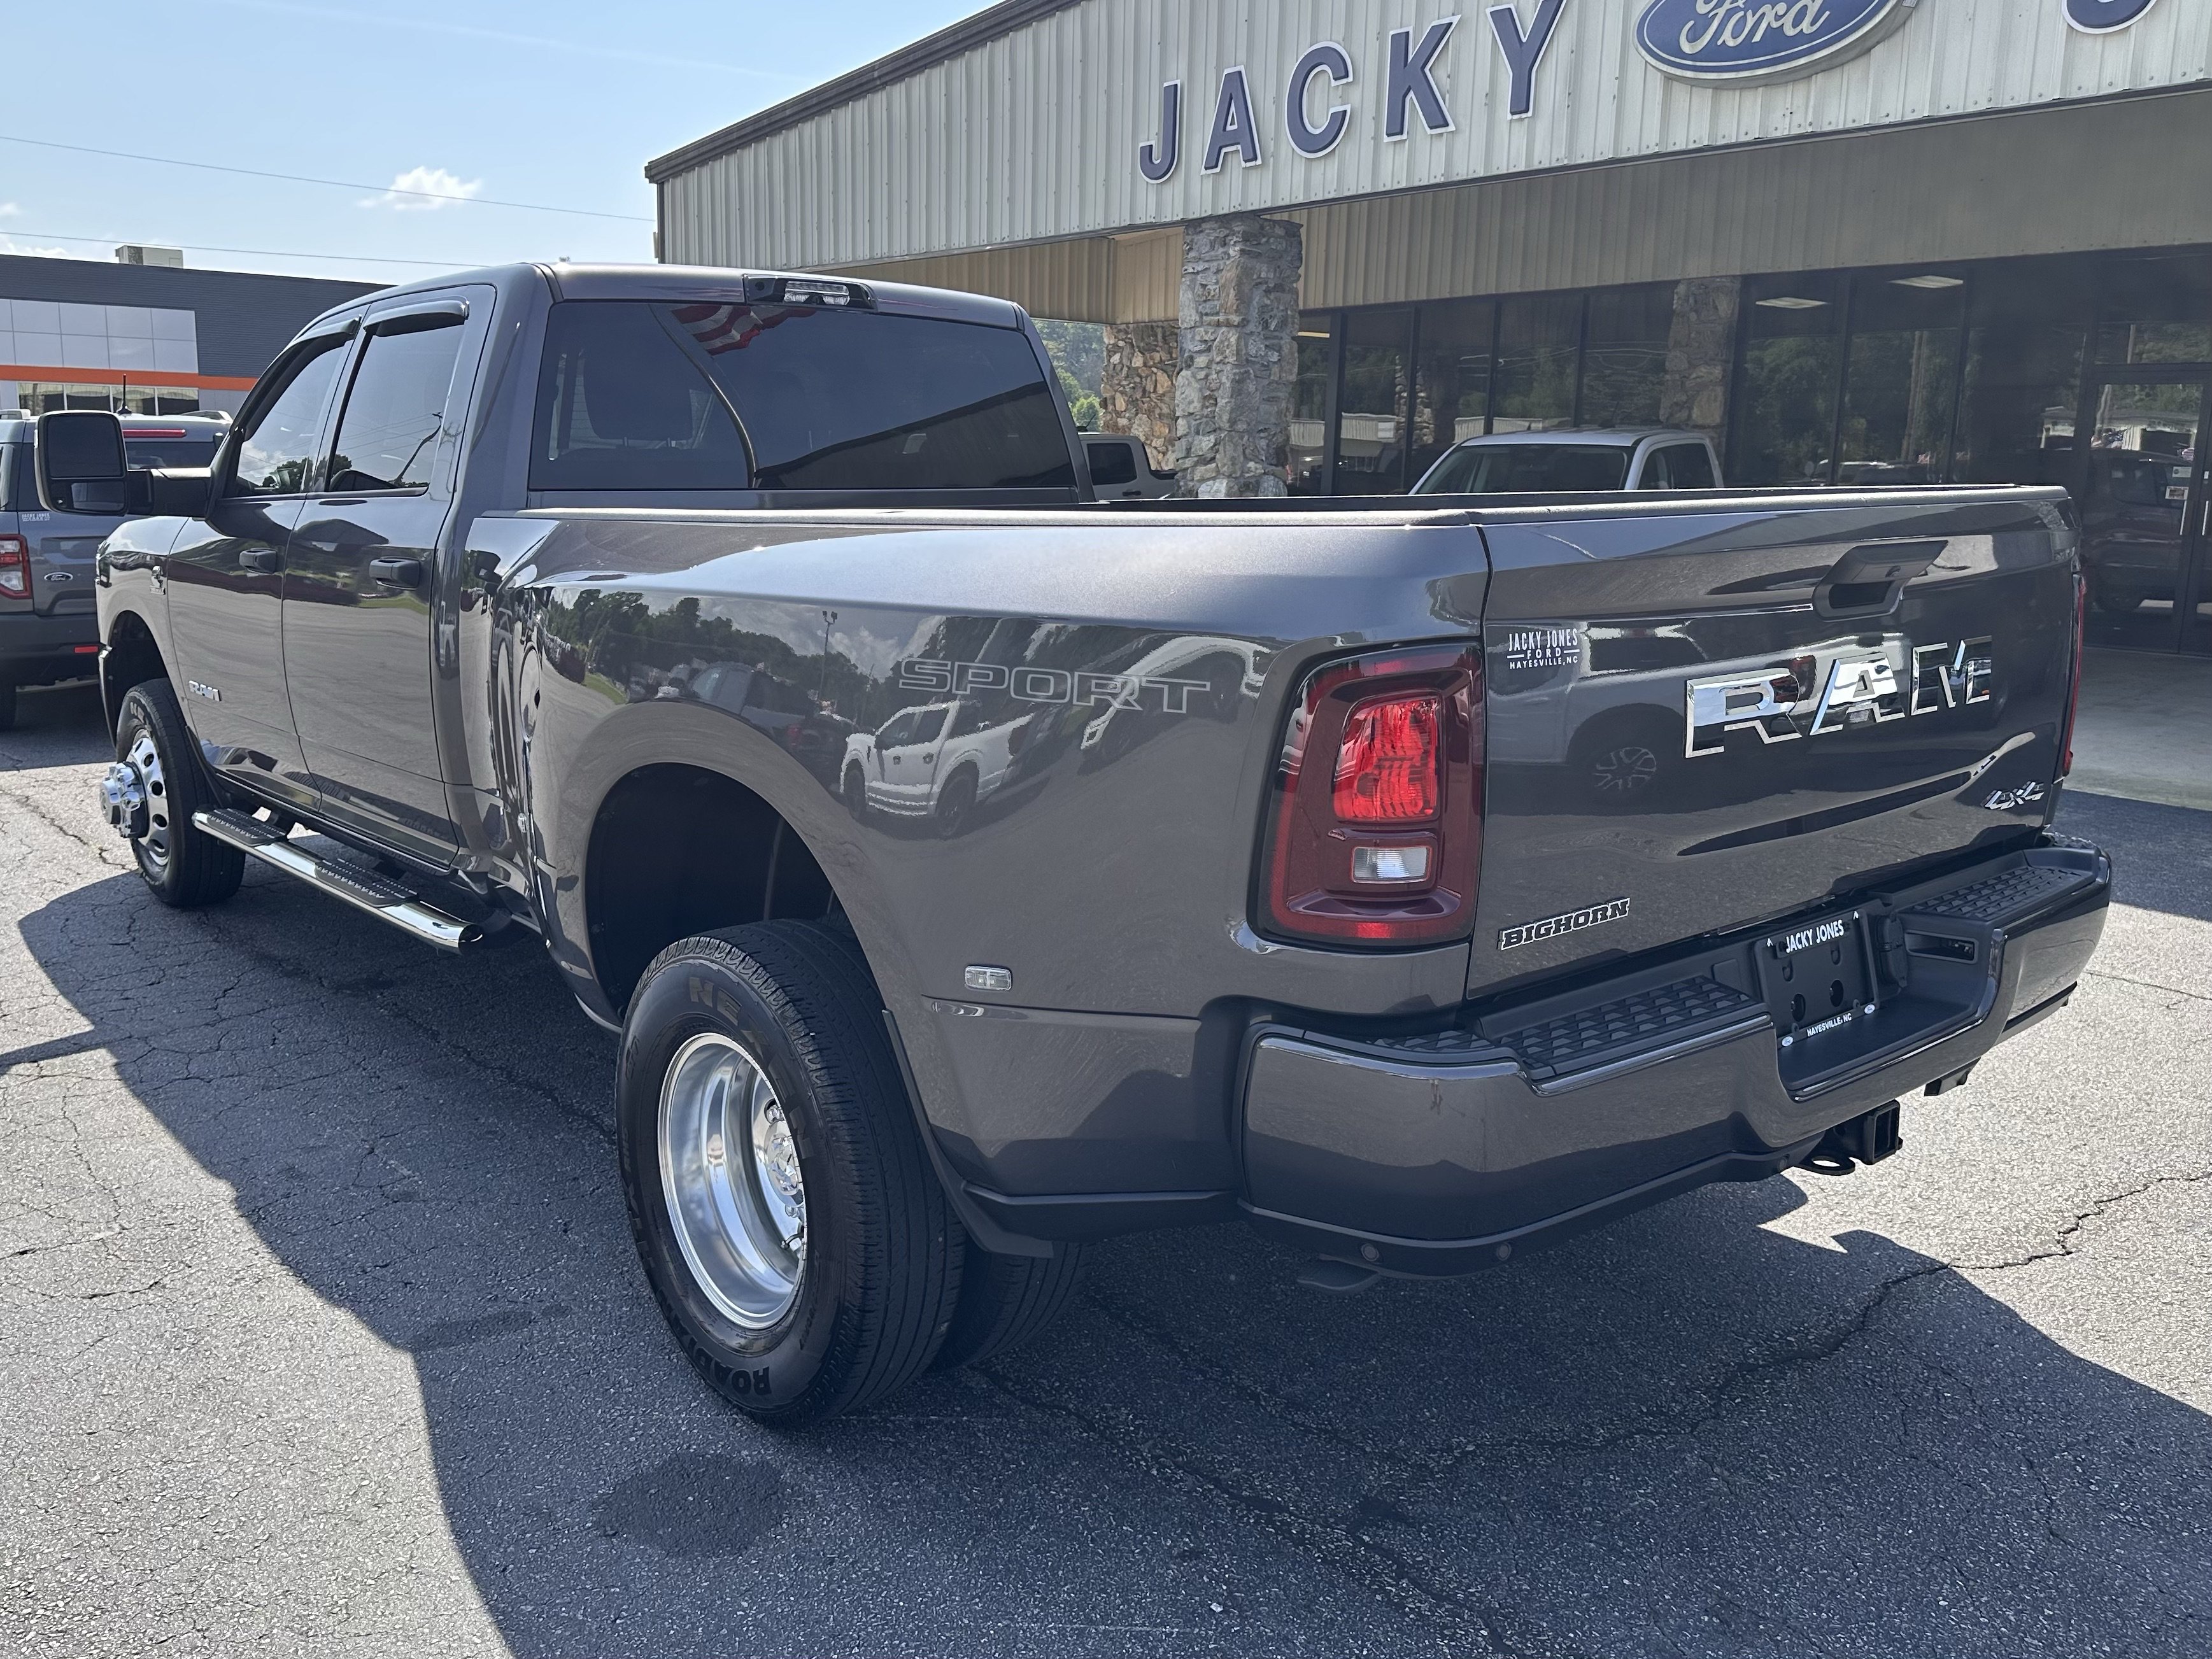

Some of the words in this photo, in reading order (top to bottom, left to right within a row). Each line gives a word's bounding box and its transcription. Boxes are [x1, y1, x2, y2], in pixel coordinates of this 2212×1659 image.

[1678, 0, 1831, 55] Ford
[1138, 0, 1566, 185] JACKY
[1508, 630, 1542, 652] JACKY
[1547, 628, 1578, 649] JONES
[1527, 647, 1561, 660] FORD
[898, 657, 1211, 714] SPORT
[1685, 635, 1992, 759] RAM
[1499, 898, 1631, 950] BIGHORN
[1785, 928, 1813, 954] JACKY
[1815, 919, 1845, 943] JONES
